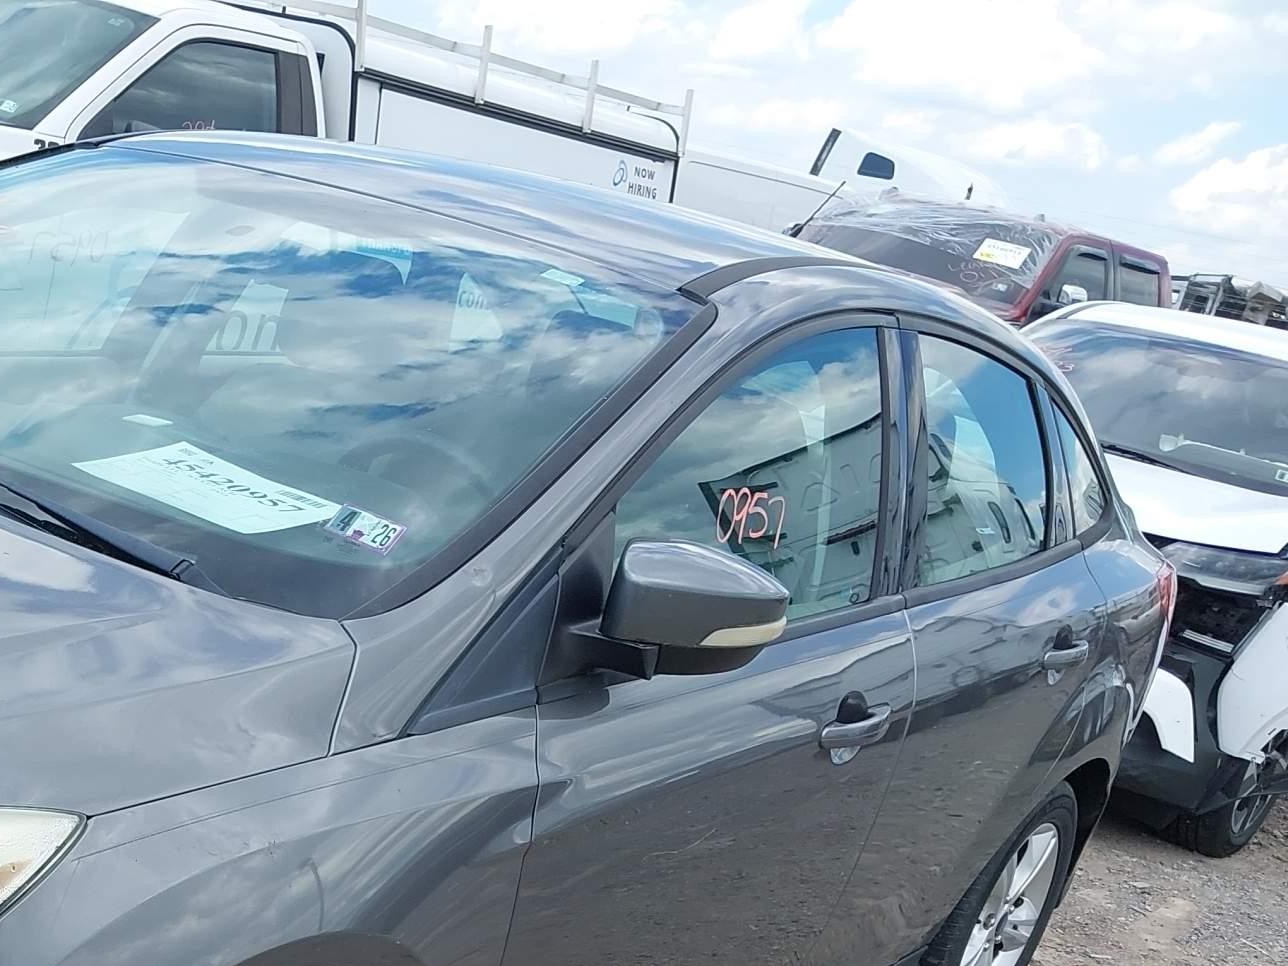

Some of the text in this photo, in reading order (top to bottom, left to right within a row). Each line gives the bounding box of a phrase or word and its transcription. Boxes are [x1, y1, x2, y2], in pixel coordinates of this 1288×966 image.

[626, 182, 658, 200] HIRING
[633, 166, 656, 181] NOW
[162, 458, 307, 512] 45420957
[336, 511, 358, 532] 4
[371, 524, 397, 547] 26
[716, 487, 786, 550] 0957
